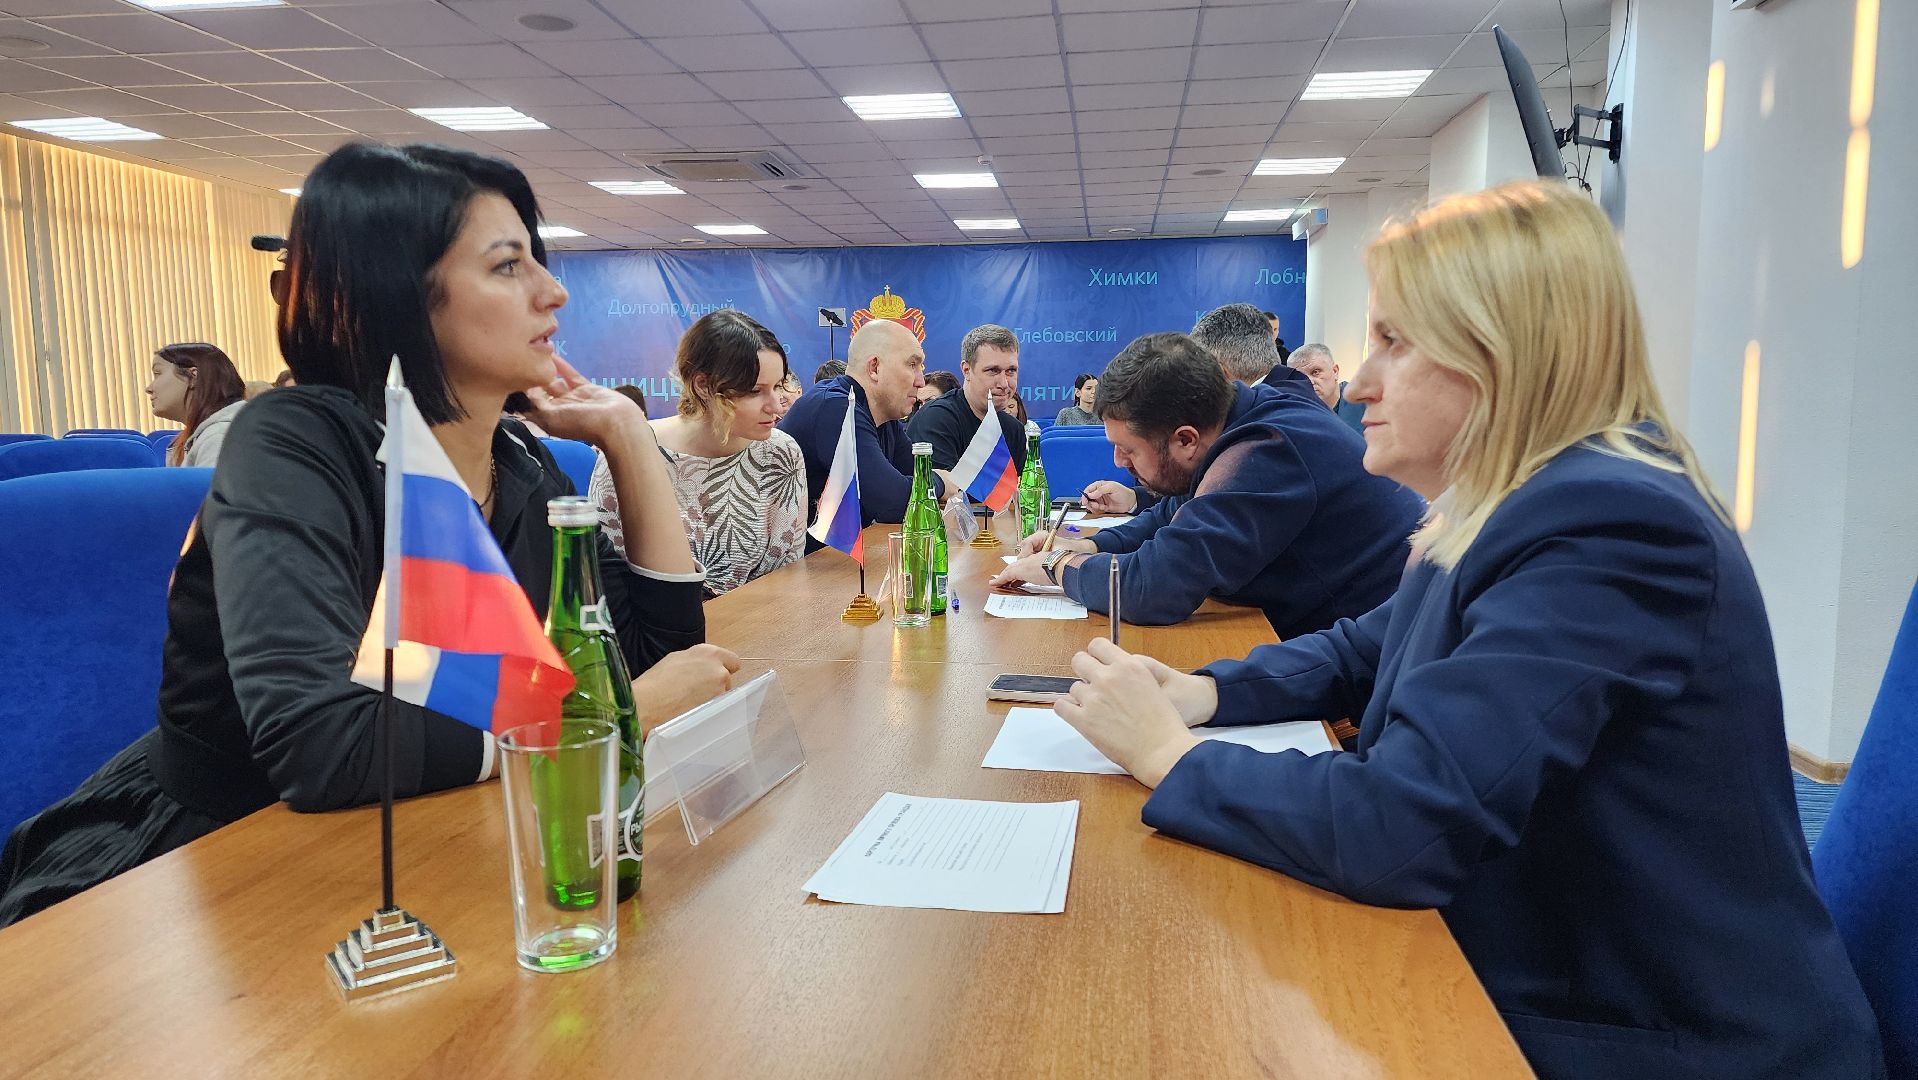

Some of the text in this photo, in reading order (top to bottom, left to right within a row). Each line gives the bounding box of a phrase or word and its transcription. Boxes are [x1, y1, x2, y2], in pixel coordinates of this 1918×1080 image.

[1088, 267, 1158, 286] Химки
[1255, 267, 1306, 285] Лобн
[1013, 326, 1118, 344] Глебовский
